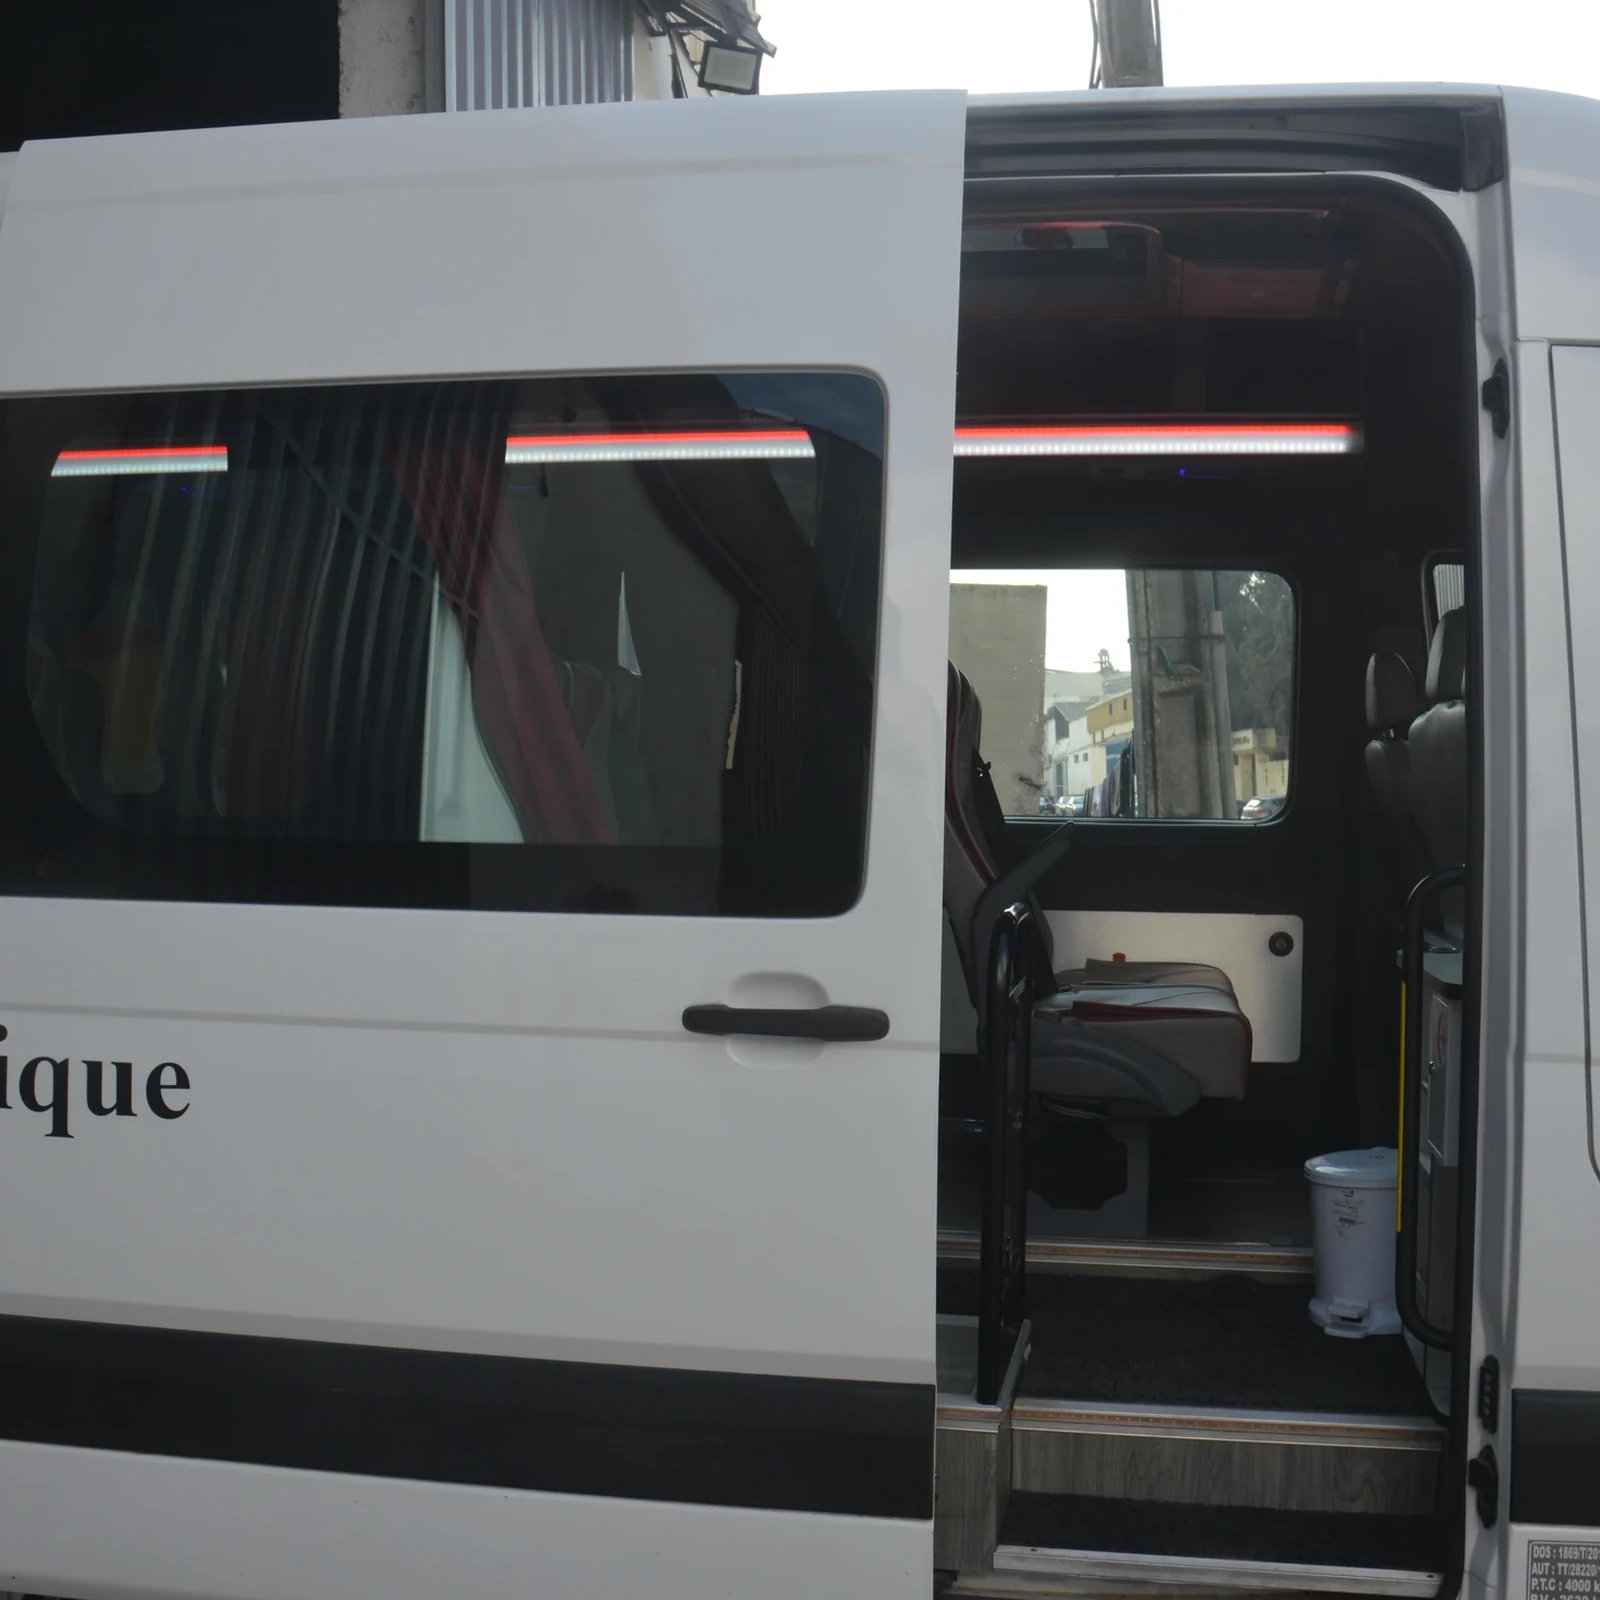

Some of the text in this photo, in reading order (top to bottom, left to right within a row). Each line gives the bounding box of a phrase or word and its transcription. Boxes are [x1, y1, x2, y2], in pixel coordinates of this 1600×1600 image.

[1533, 1545, 1551, 1558] DOS
[1558, 1546, 1600, 1560] 1869/T/20
[1531, 1562, 1550, 1575] AUT
[1557, 1563, 1600, 1577] TT/28220/
[1531, 1577, 1556, 1591] P.T.C
[1565, 1578, 1591, 1592] 4000
